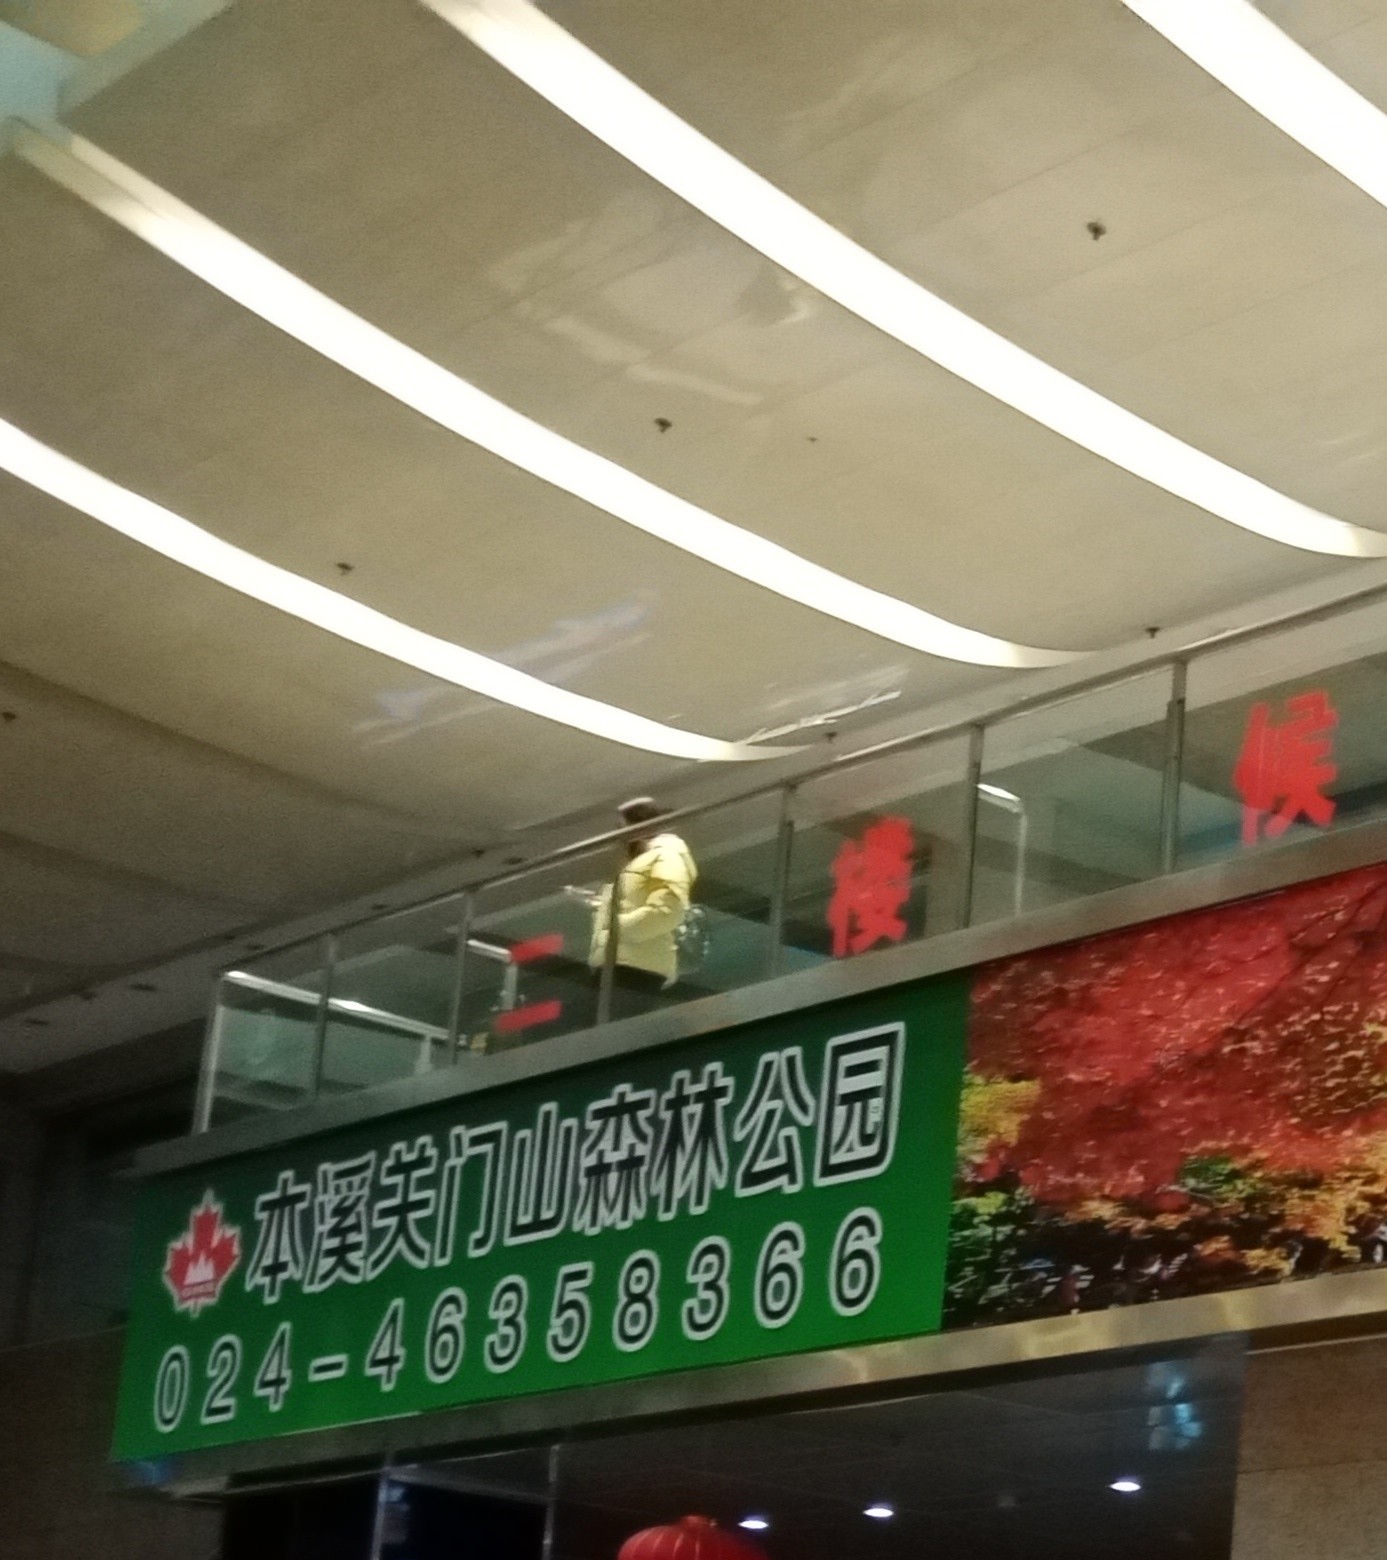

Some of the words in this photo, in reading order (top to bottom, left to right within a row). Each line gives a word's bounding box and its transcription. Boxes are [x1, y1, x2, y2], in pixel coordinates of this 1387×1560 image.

[245, 1020, 906, 1306] 本溪关门山森林公园
[152, 1206, 883, 1434] 024-46358366
